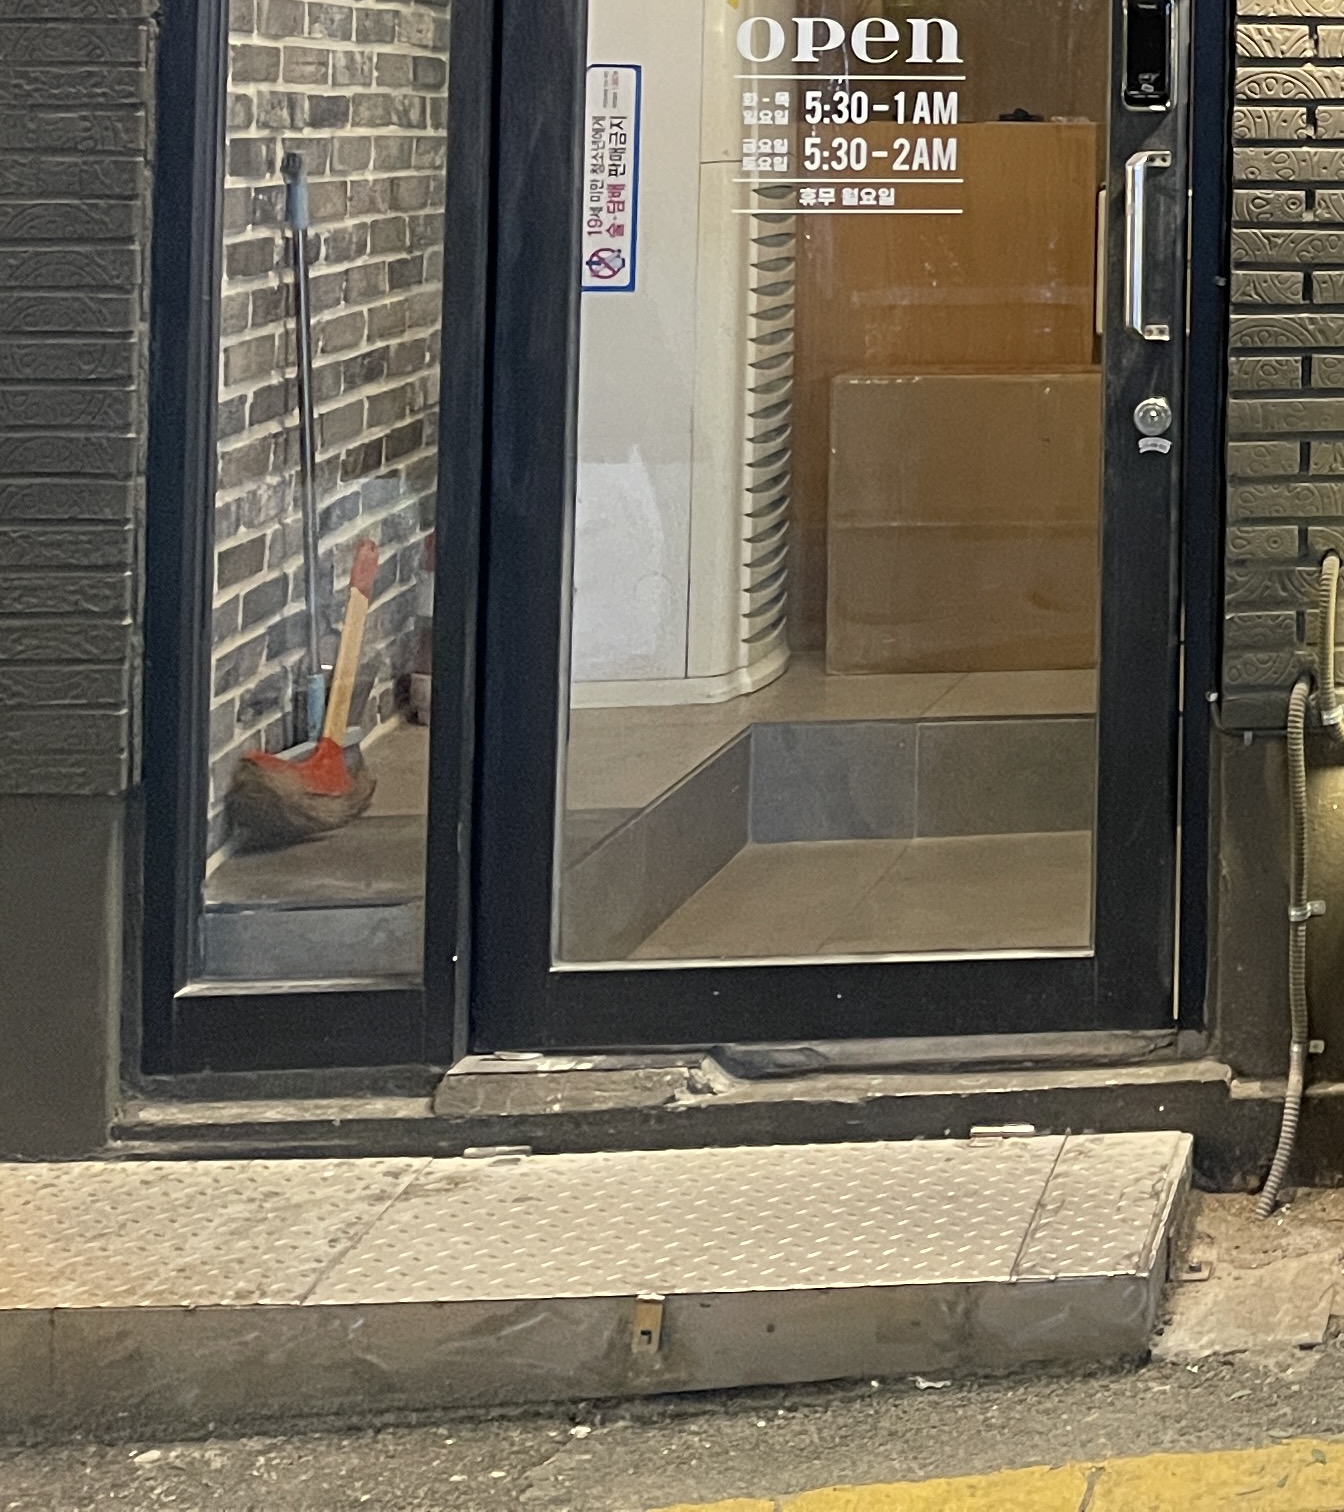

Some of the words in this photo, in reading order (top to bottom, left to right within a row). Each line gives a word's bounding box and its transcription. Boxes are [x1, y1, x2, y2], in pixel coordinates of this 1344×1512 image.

[743, 109, 789, 125] 일요일
[799, 187, 836, 207] 휴무
[841, 187, 896, 206] 월요일
